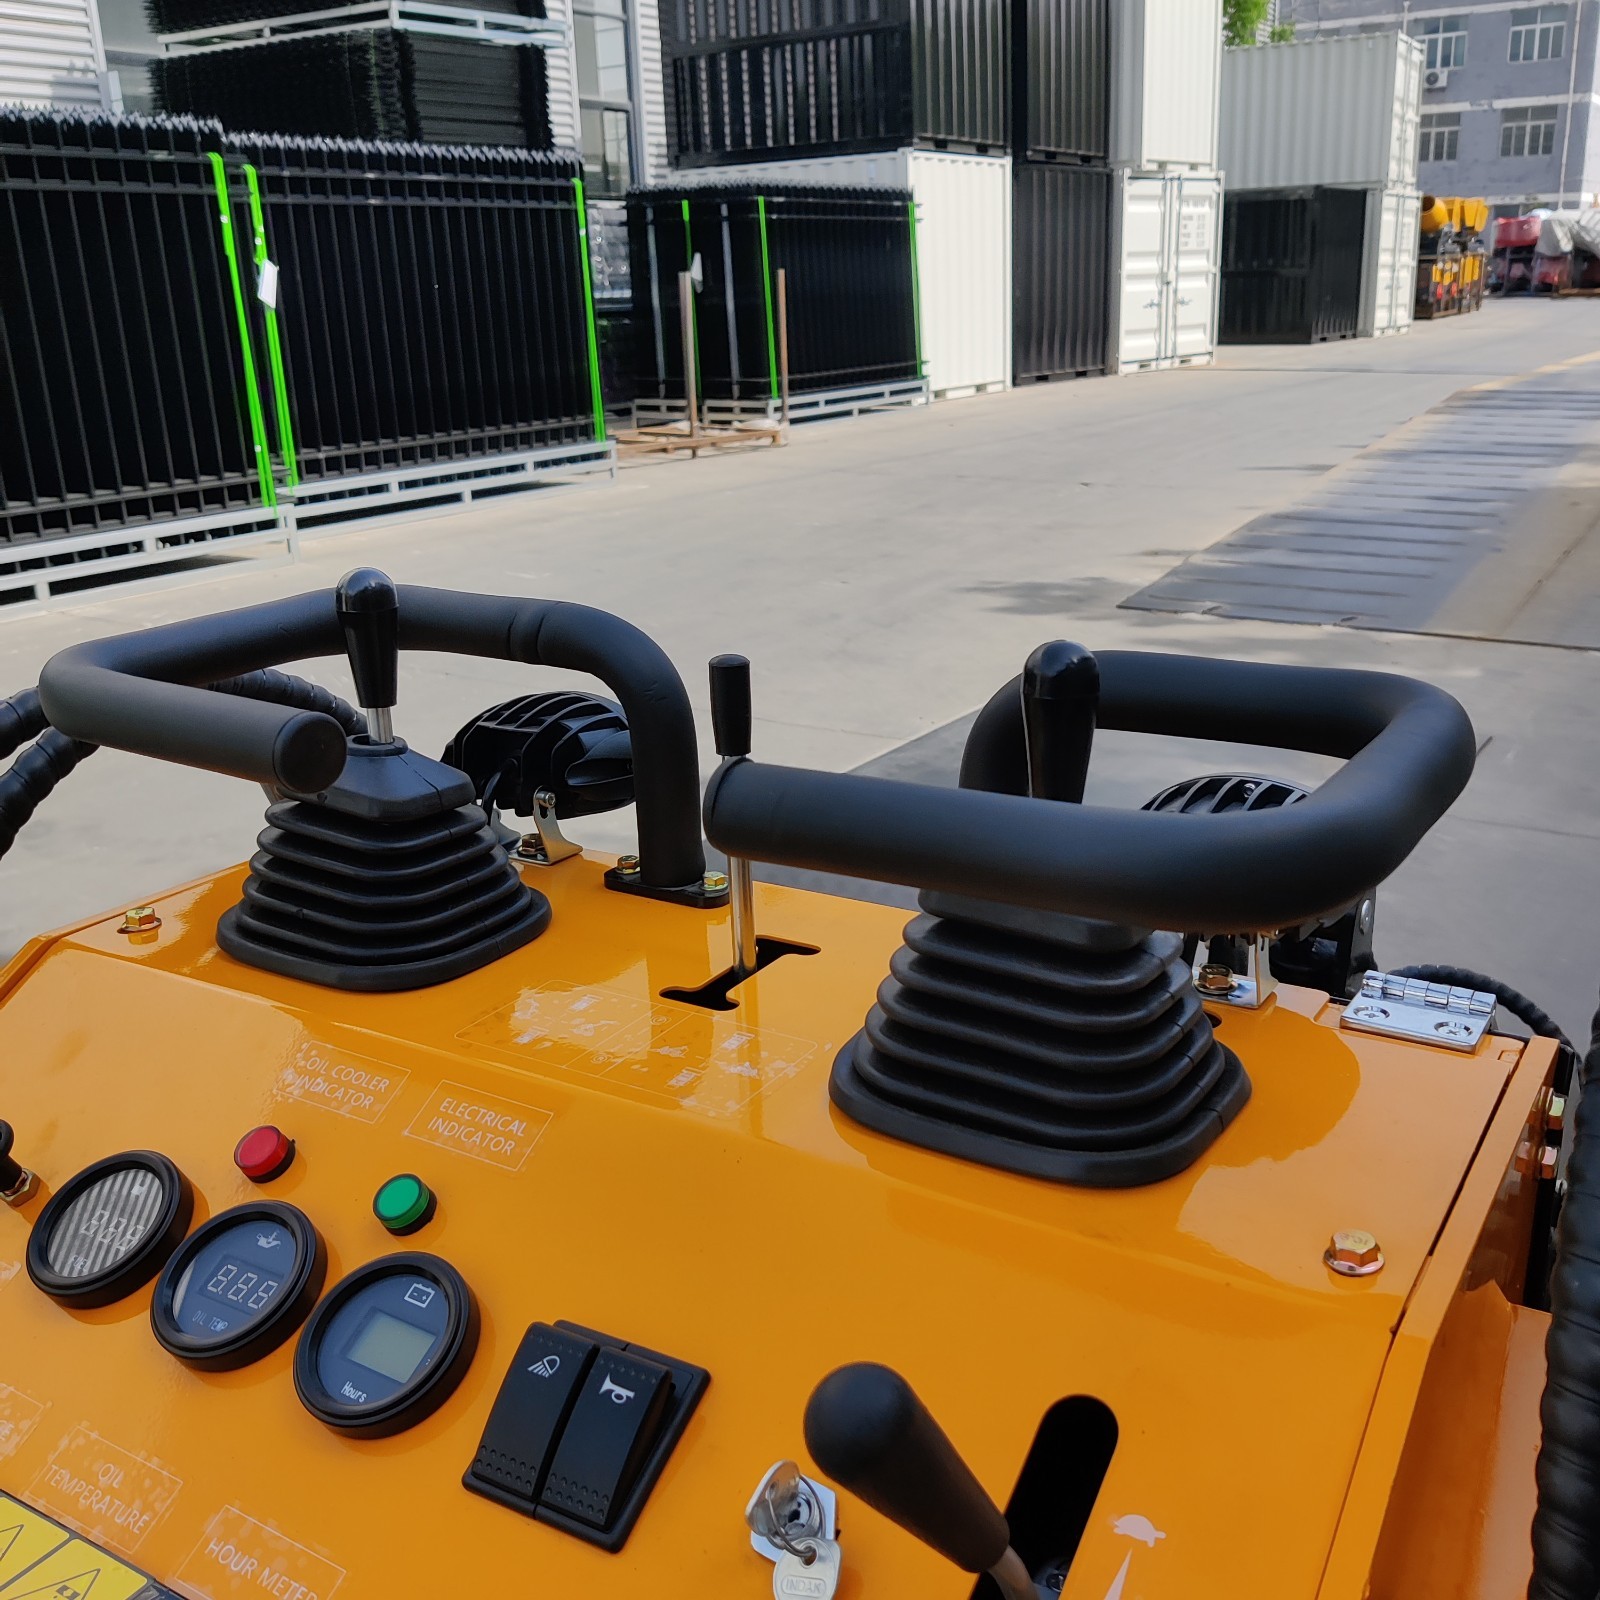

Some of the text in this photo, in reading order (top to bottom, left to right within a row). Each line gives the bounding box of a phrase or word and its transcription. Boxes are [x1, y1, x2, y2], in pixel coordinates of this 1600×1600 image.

[294, 1075, 374, 1109] INDICATOR
[306, 1057, 390, 1092] OIL COOLER
[440, 1098, 527, 1136] ELECTRICAL
[428, 1116, 515, 1155] INDICATOR
[193, 1311, 228, 1332] OIL TEMP
[341, 1381, 367, 1402] Hours
[98, 1463, 124, 1488] OIL
[44, 1465, 150, 1534] TEMPERATURE
[205, 1537, 258, 1579] HOUR
